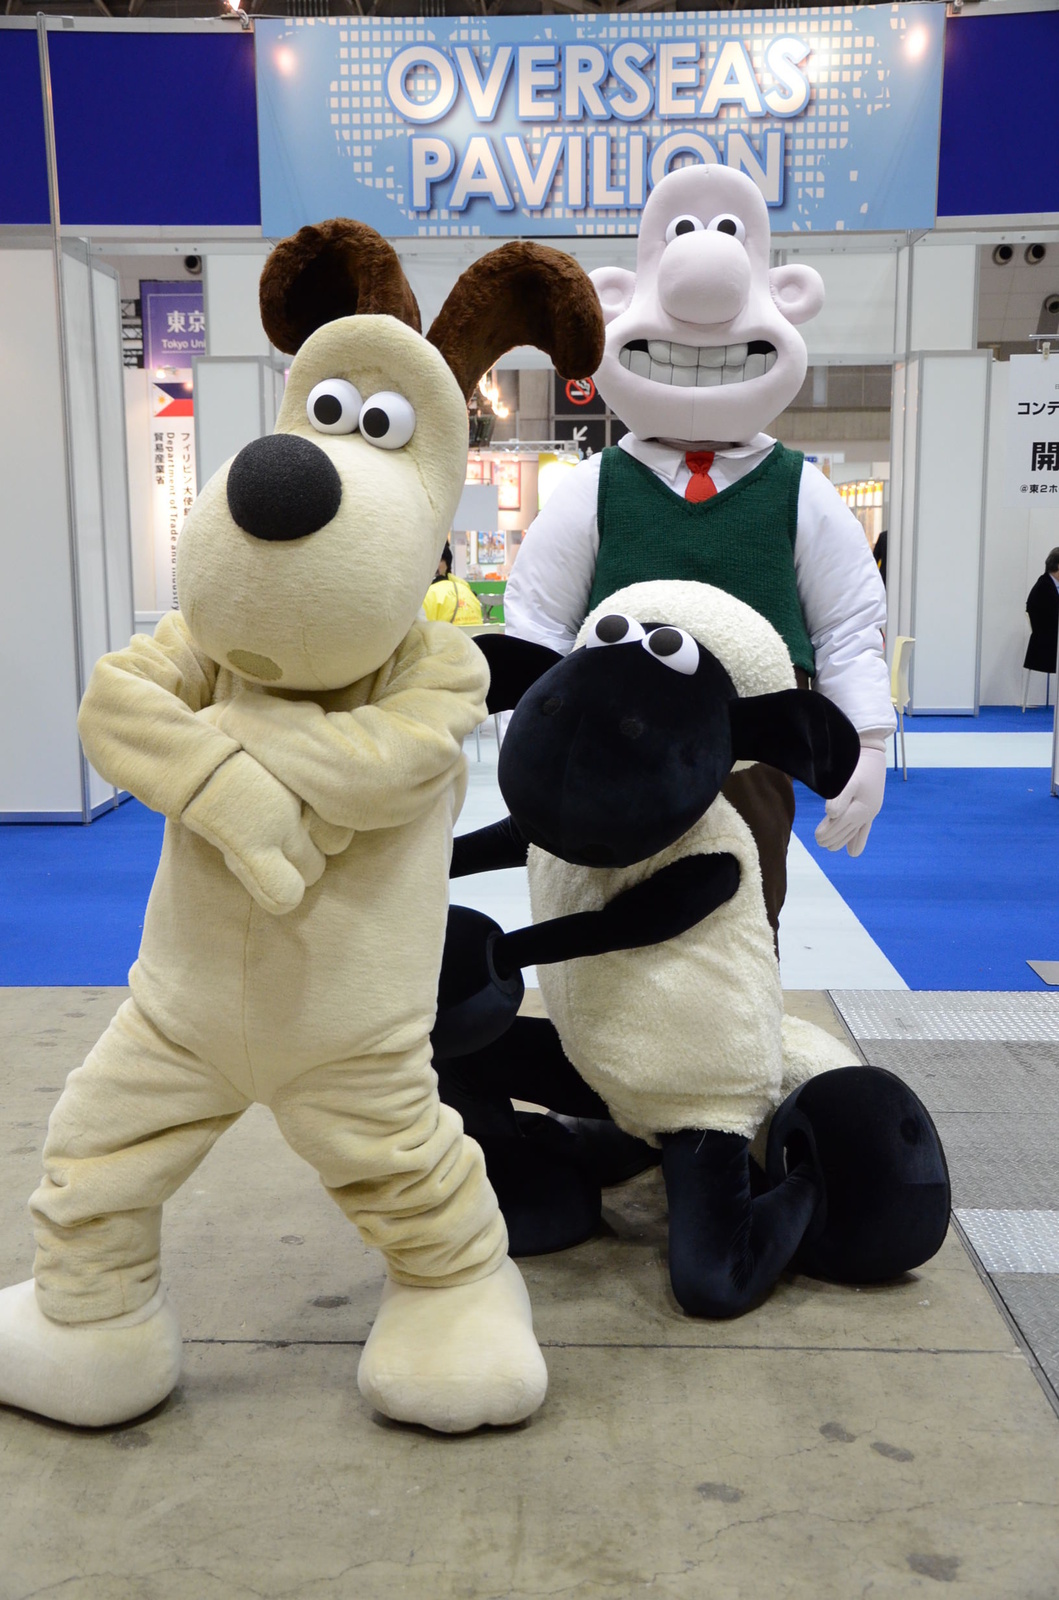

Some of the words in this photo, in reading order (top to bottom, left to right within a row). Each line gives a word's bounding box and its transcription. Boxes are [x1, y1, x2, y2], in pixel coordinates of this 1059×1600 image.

[386, 39, 812, 121] OVERSEAS
[410, 130, 785, 210] PAVILION
[161, 339, 189, 350] Tokyo
[1017, 401, 1059, 415] コンテ
[165, 432, 175, 495] Department
[169, 499, 177, 510] of
[170, 513, 178, 542] Trade
